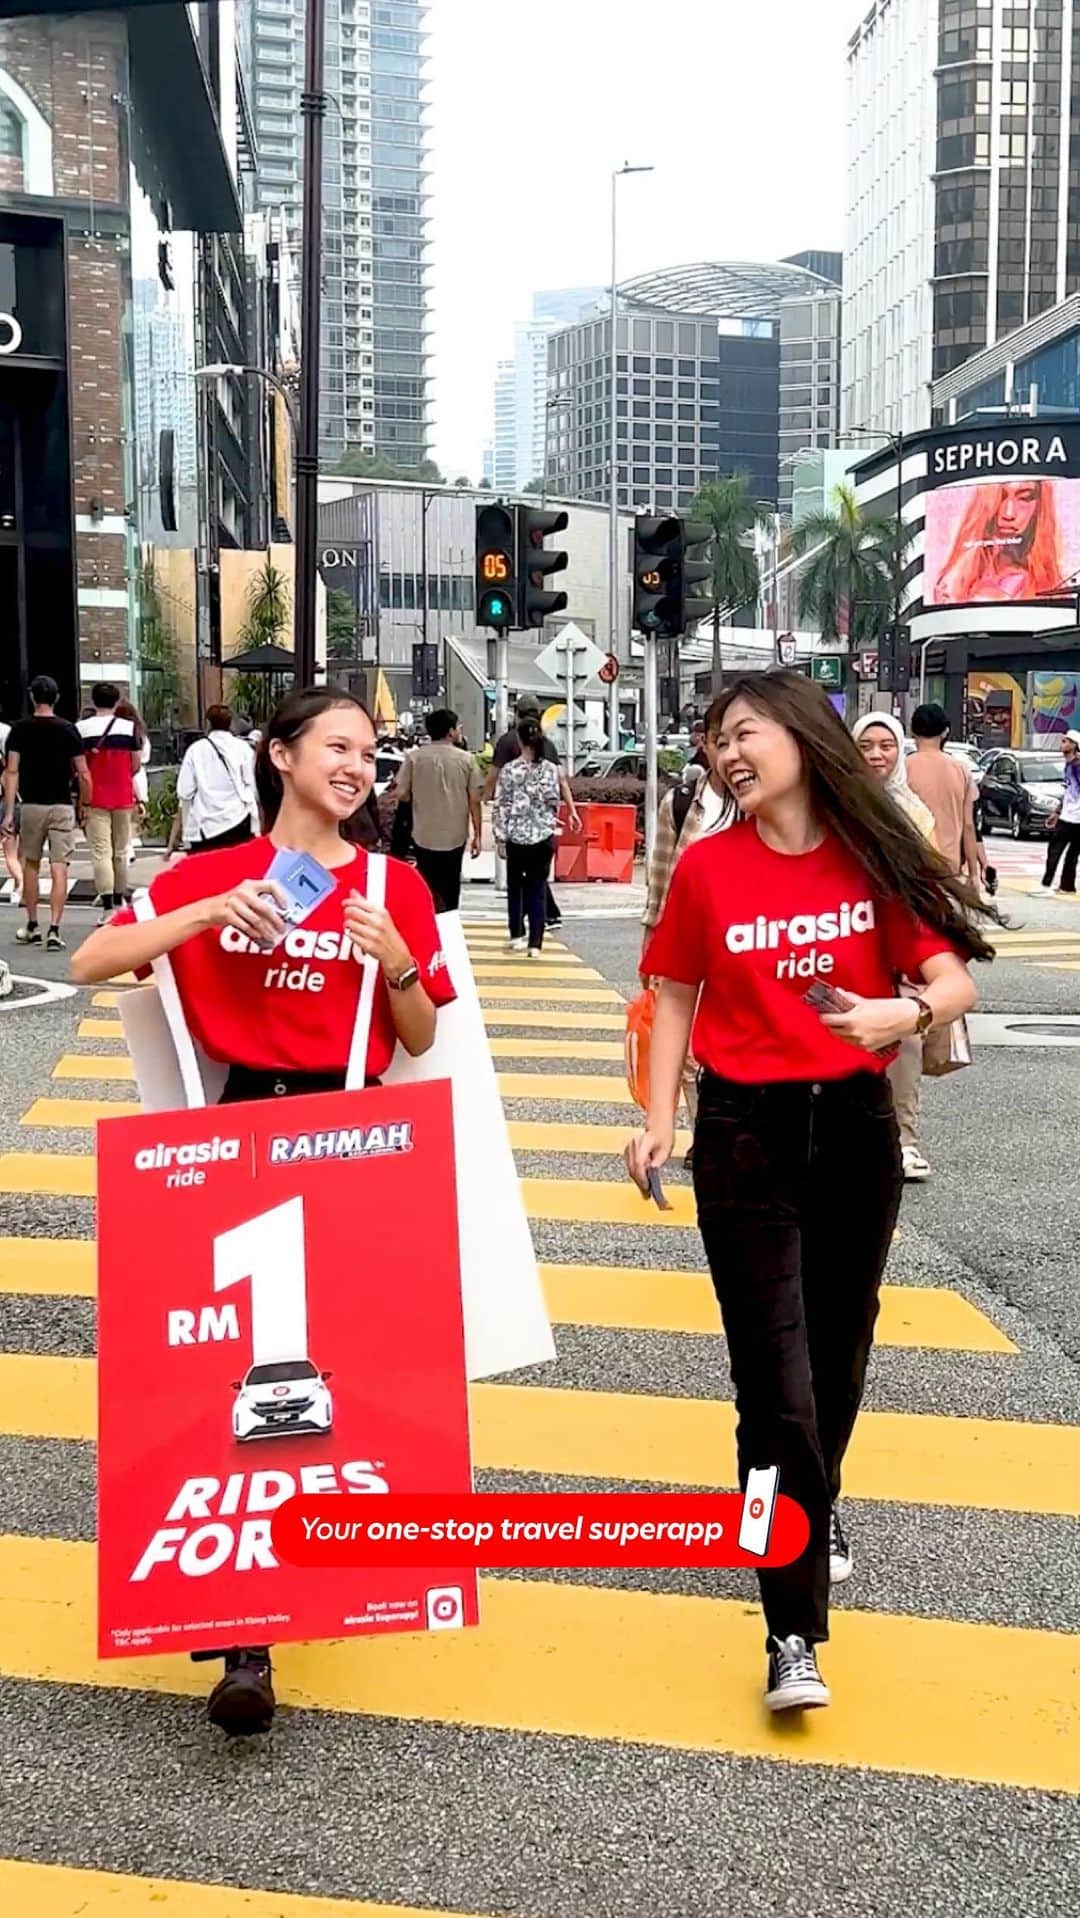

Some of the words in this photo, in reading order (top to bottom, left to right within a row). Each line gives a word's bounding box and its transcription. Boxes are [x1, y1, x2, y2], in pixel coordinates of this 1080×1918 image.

[934, 437, 1067, 472] SEPHORA
[484, 554, 507, 578] 05
[219, 925, 366, 965] aasi
[725, 900, 875, 954] airasia
[264, 963, 325, 992] ride
[776, 948, 835, 979] ride
[135, 1136, 240, 1170] airasia
[269, 1122, 411, 1163] RAHMAH
[166, 1167, 206, 1189] ride
[168, 1304, 240, 1346] RM
[213, 1195, 308, 1367] 1
[129, 1519, 280, 1582] FOR
